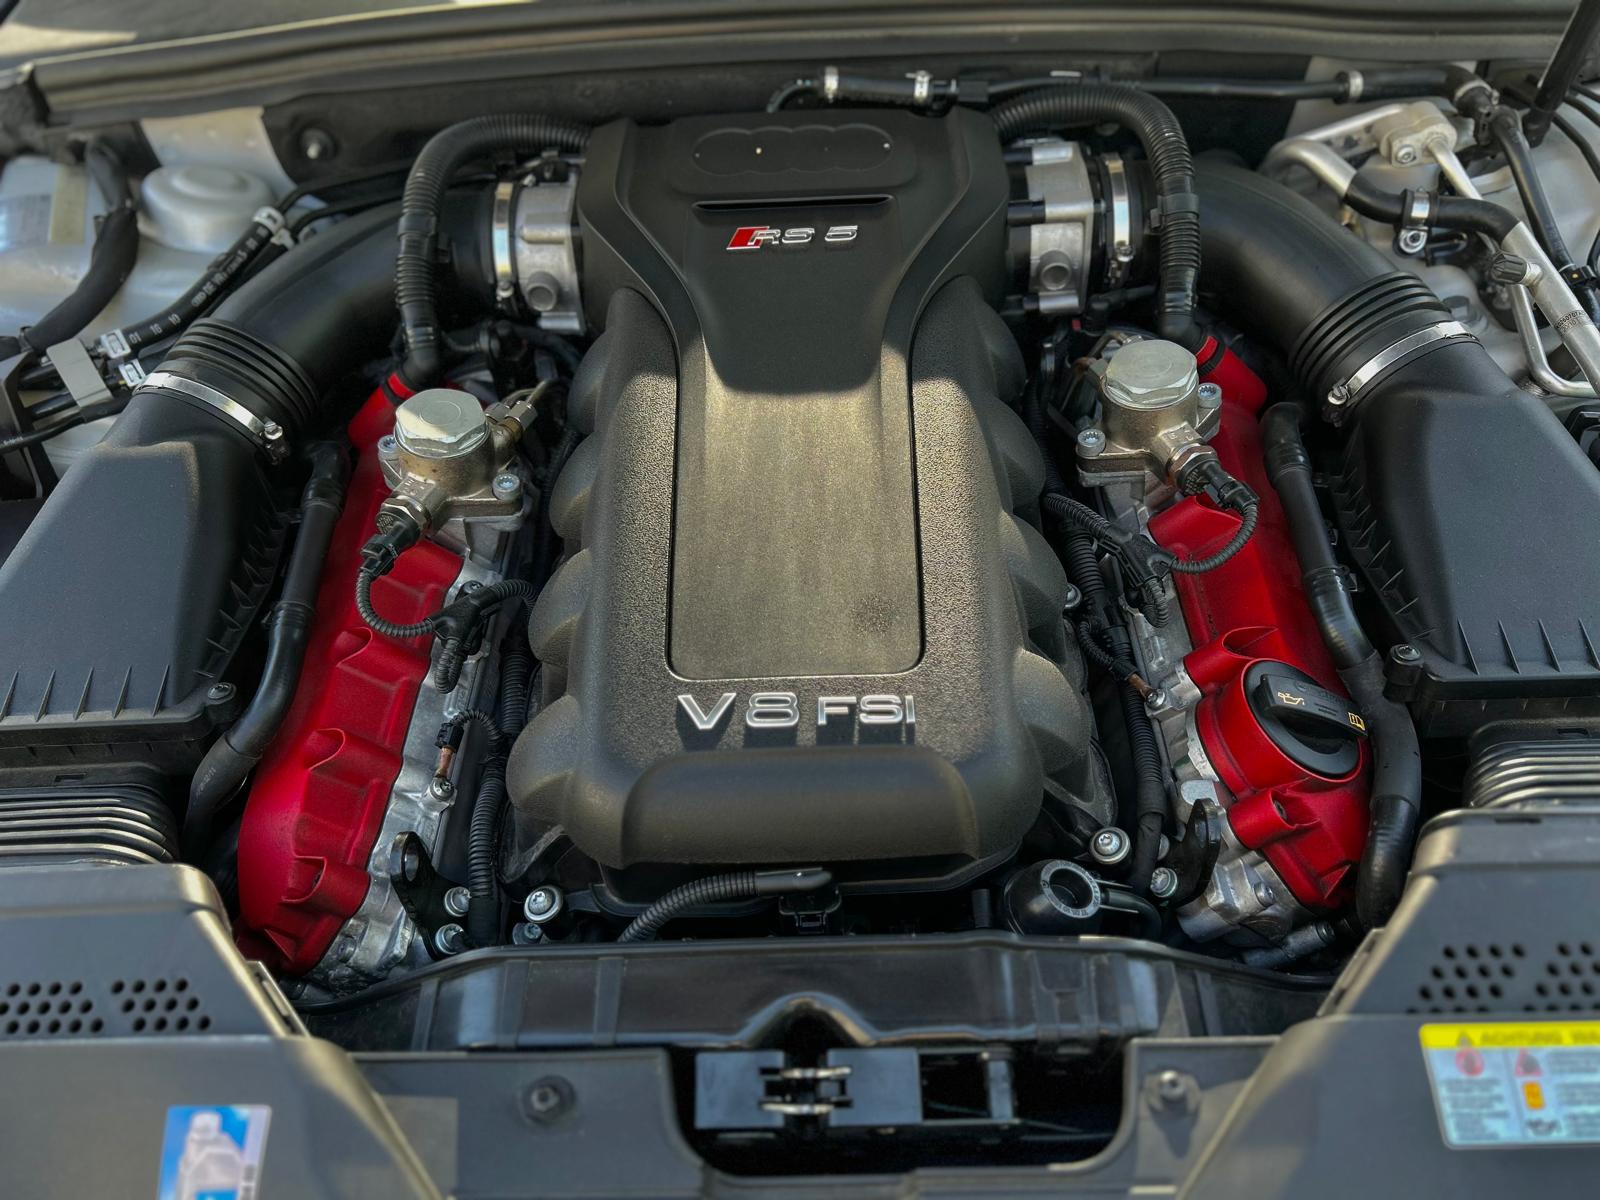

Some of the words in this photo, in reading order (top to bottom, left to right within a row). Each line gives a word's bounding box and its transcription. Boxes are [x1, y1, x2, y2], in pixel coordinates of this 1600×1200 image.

[744, 226, 816, 246] RS
[825, 225, 858, 242] 5
[817, 695, 916, 727] FSI
